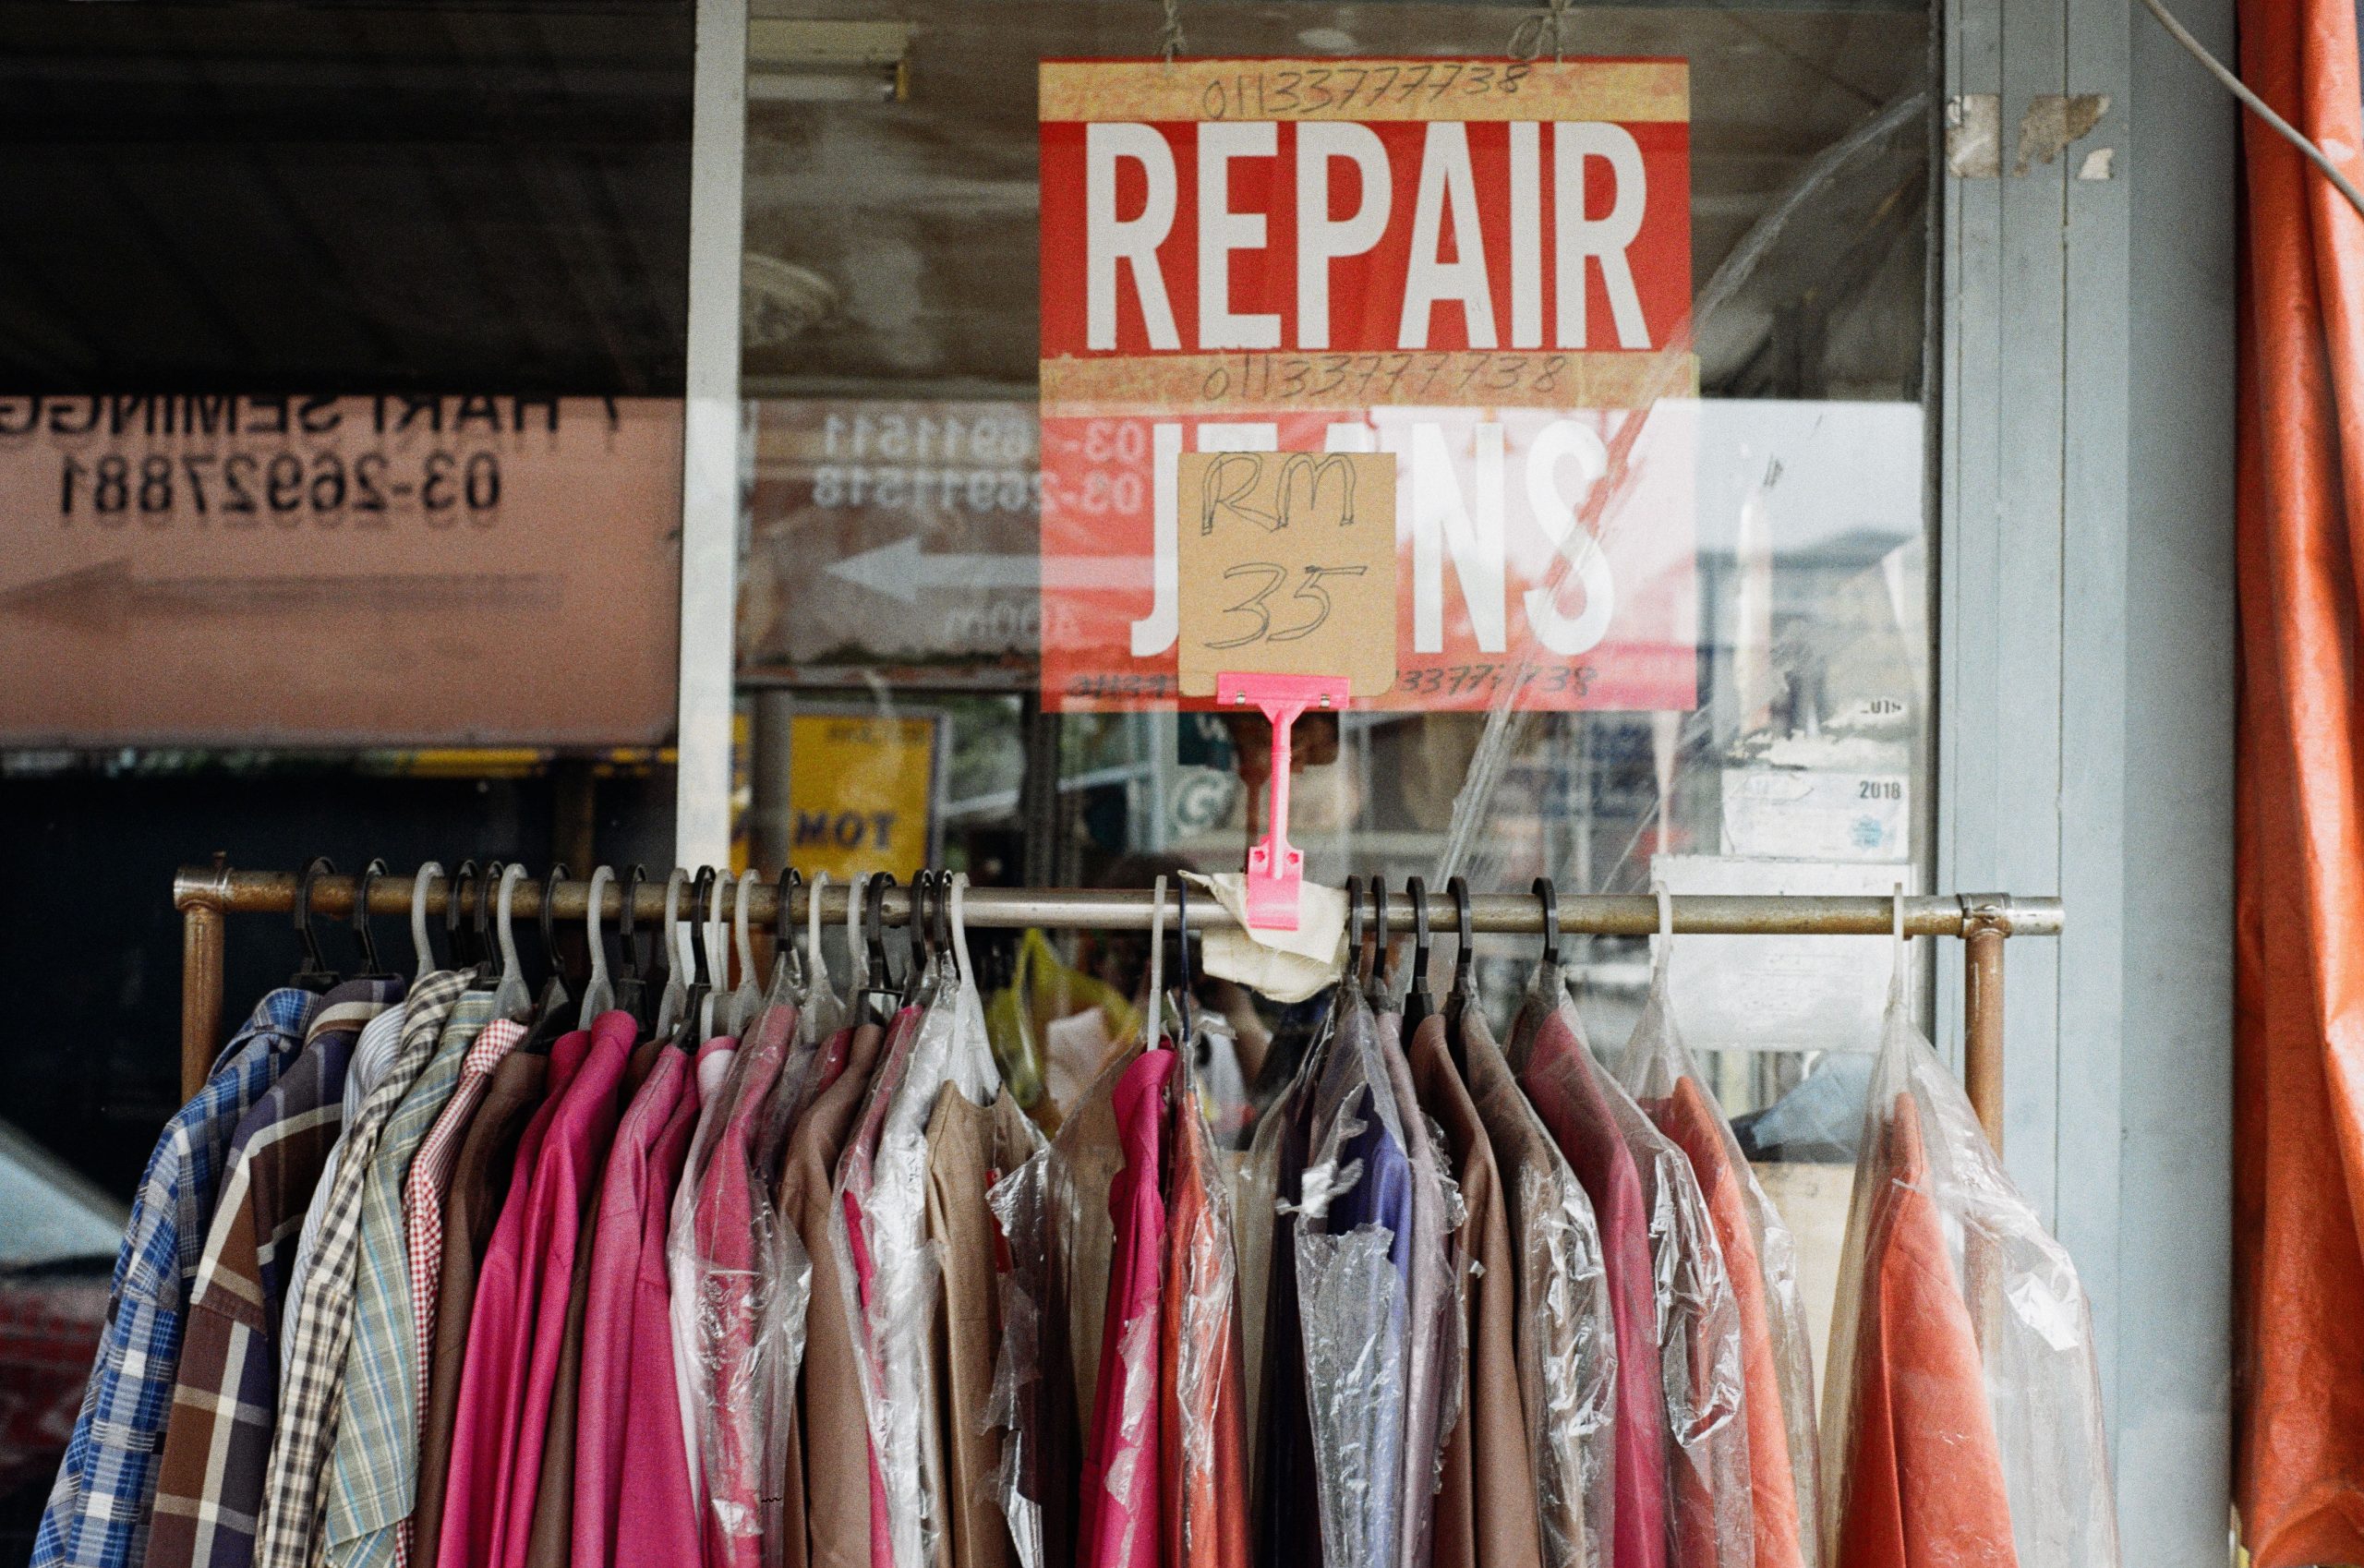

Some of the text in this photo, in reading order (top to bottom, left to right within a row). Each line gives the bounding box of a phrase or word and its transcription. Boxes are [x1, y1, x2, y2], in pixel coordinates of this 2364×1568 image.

[1202, 63, 1530, 120] 01133777738
[1085, 121, 1653, 350] REPAIR
[1201, 353, 1568, 402] 01133777738
[1201, 451, 1356, 535] RM
[1129, 420, 1612, 657] JNS
[1203, 562, 1368, 650] 35
[1858, 779, 1902, 801] 2018
